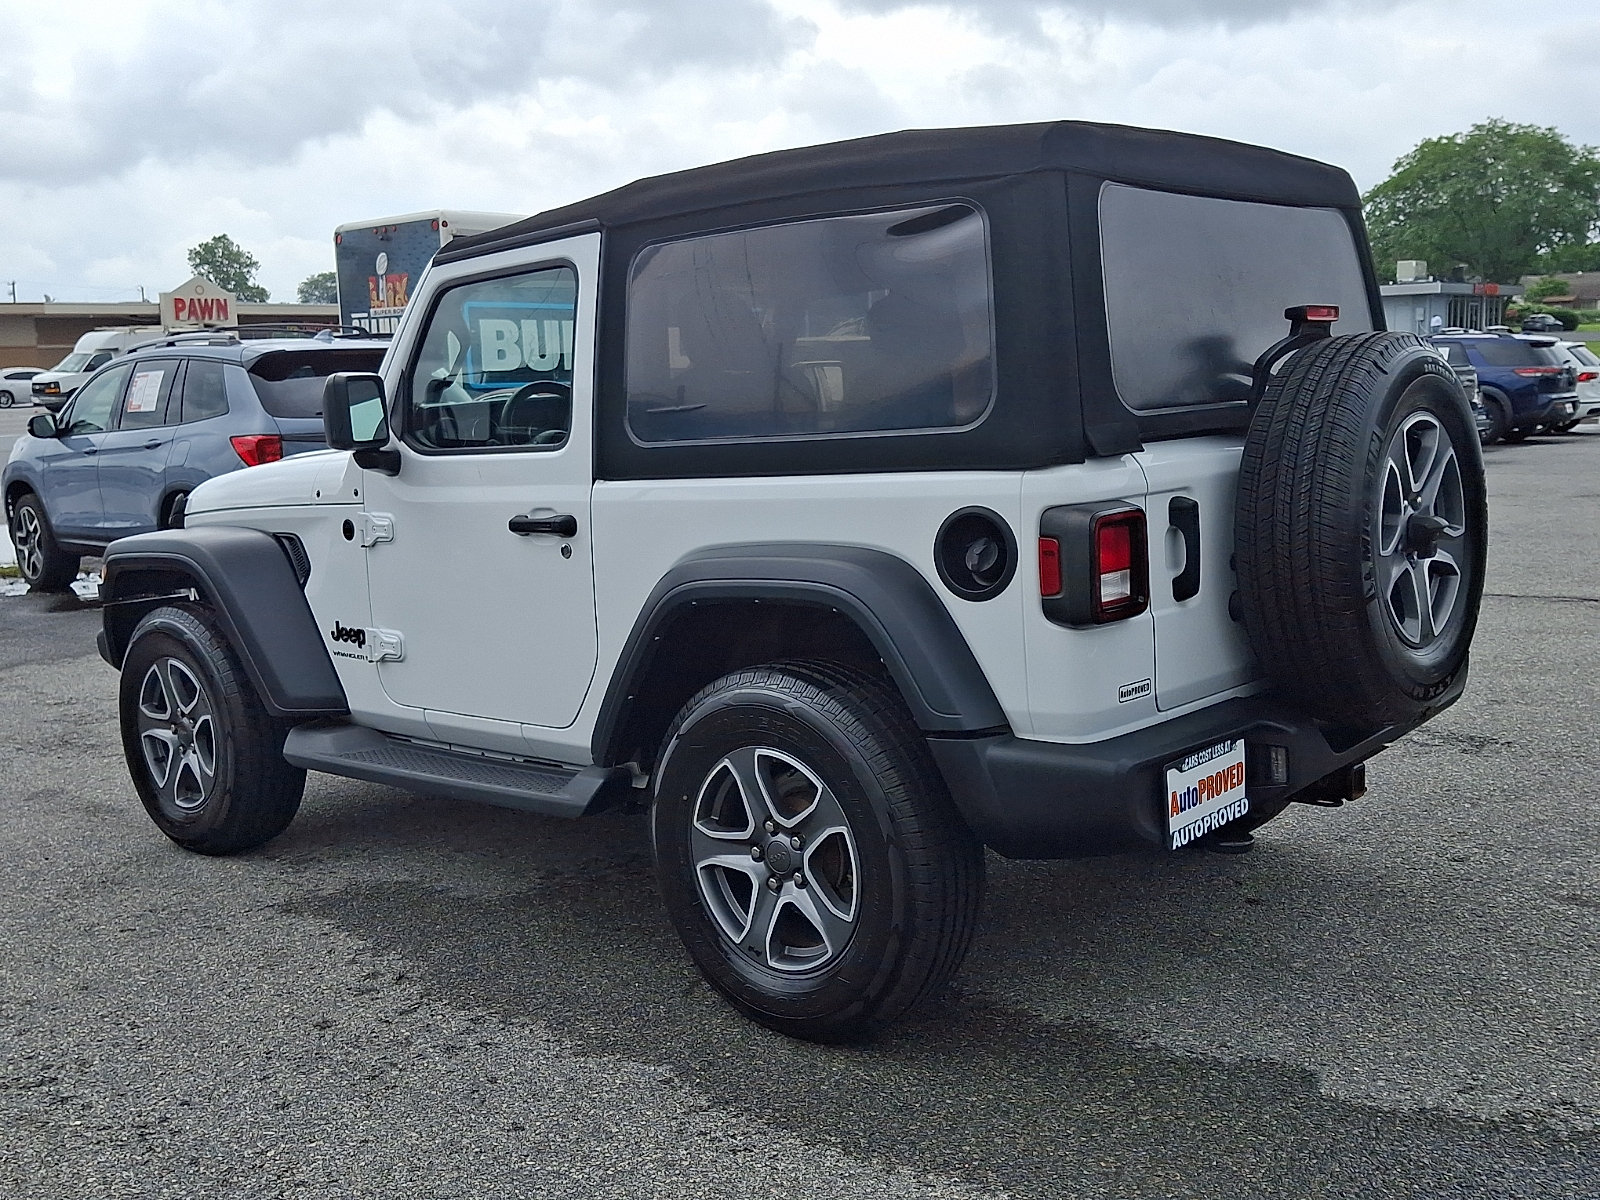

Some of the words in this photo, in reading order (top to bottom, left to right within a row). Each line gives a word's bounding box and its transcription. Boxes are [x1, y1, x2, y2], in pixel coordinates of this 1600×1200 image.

[174, 298, 229, 320] PAWN
[373, 308, 391, 316] SUPER
[330, 620, 366, 649] Jeep
[1185, 754, 1199, 770] CARS
[1199, 749, 1212, 763] COST
[1212, 743, 1224, 759] LESS
[1224, 740, 1231, 754] AT
[1170, 762, 1244, 818] AutoPROVED
[1172, 798, 1249, 850] AUTOPROVED
